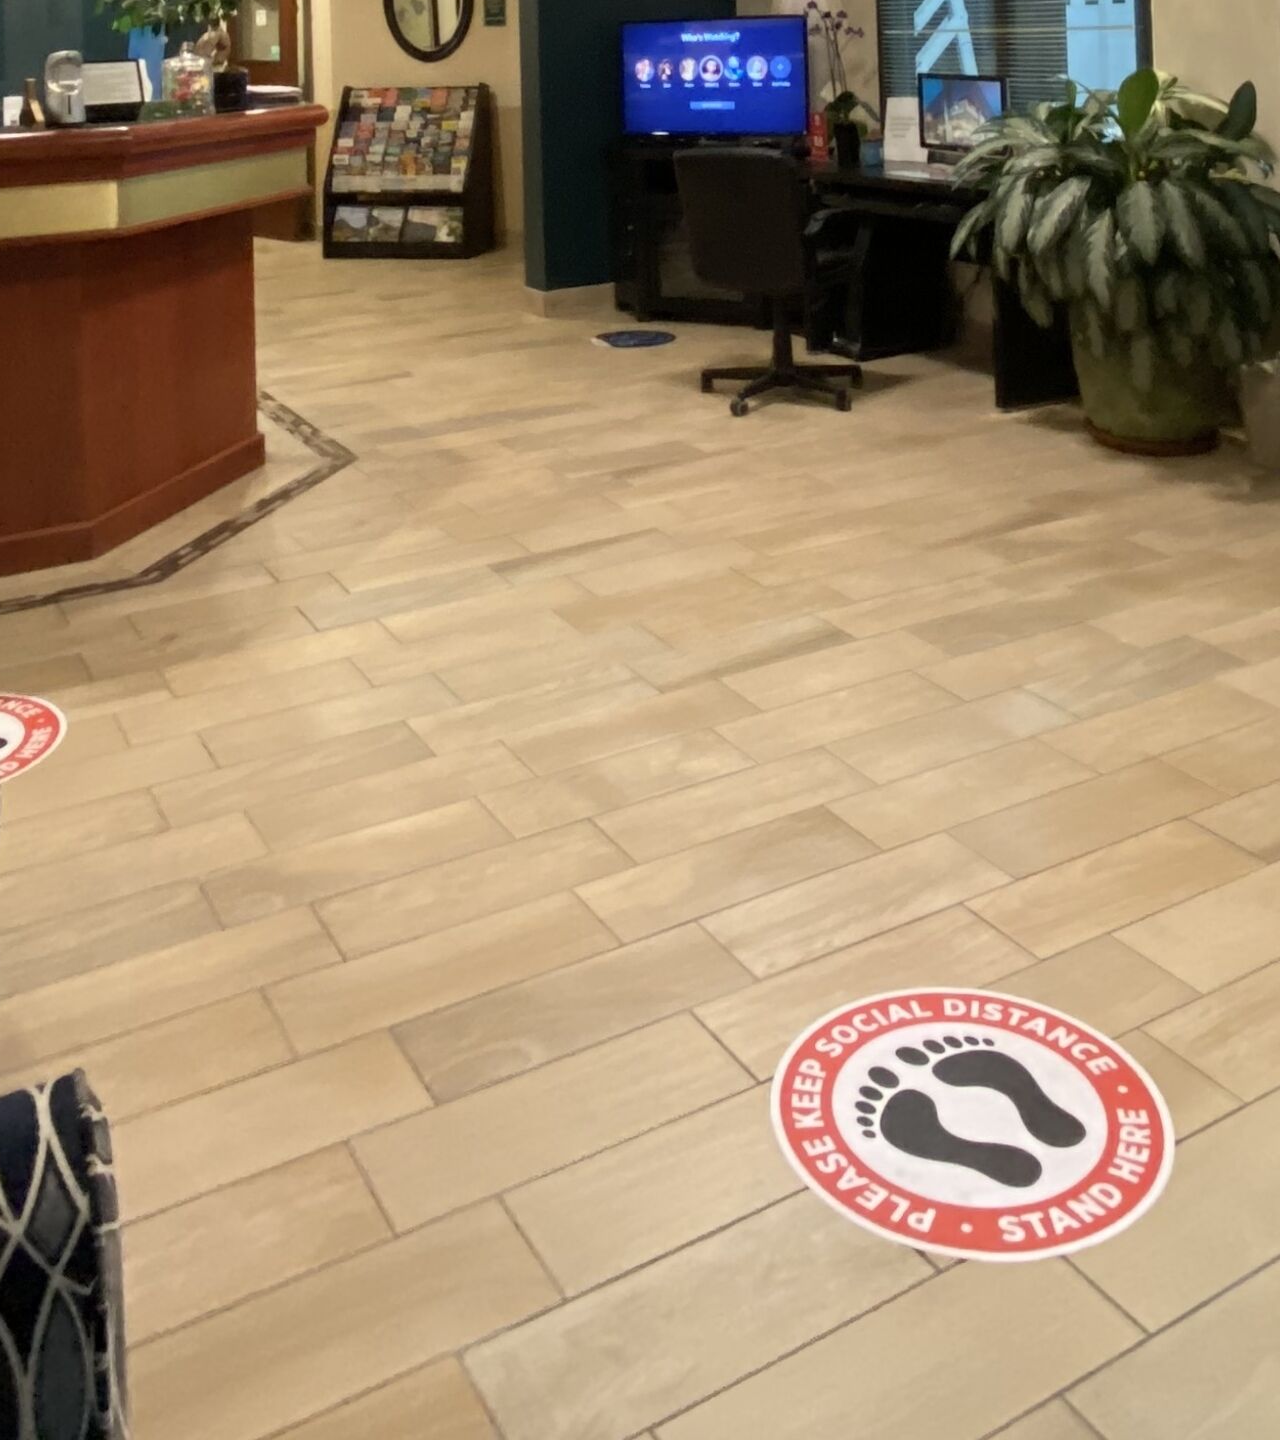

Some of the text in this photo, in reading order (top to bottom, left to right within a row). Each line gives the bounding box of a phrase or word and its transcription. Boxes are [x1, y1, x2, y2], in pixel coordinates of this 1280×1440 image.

[791, 998, 1119, 1234] PLEASE KEEP SOCIAL DISTANCE
[997, 1107, 1152, 1243] STAND HERE
